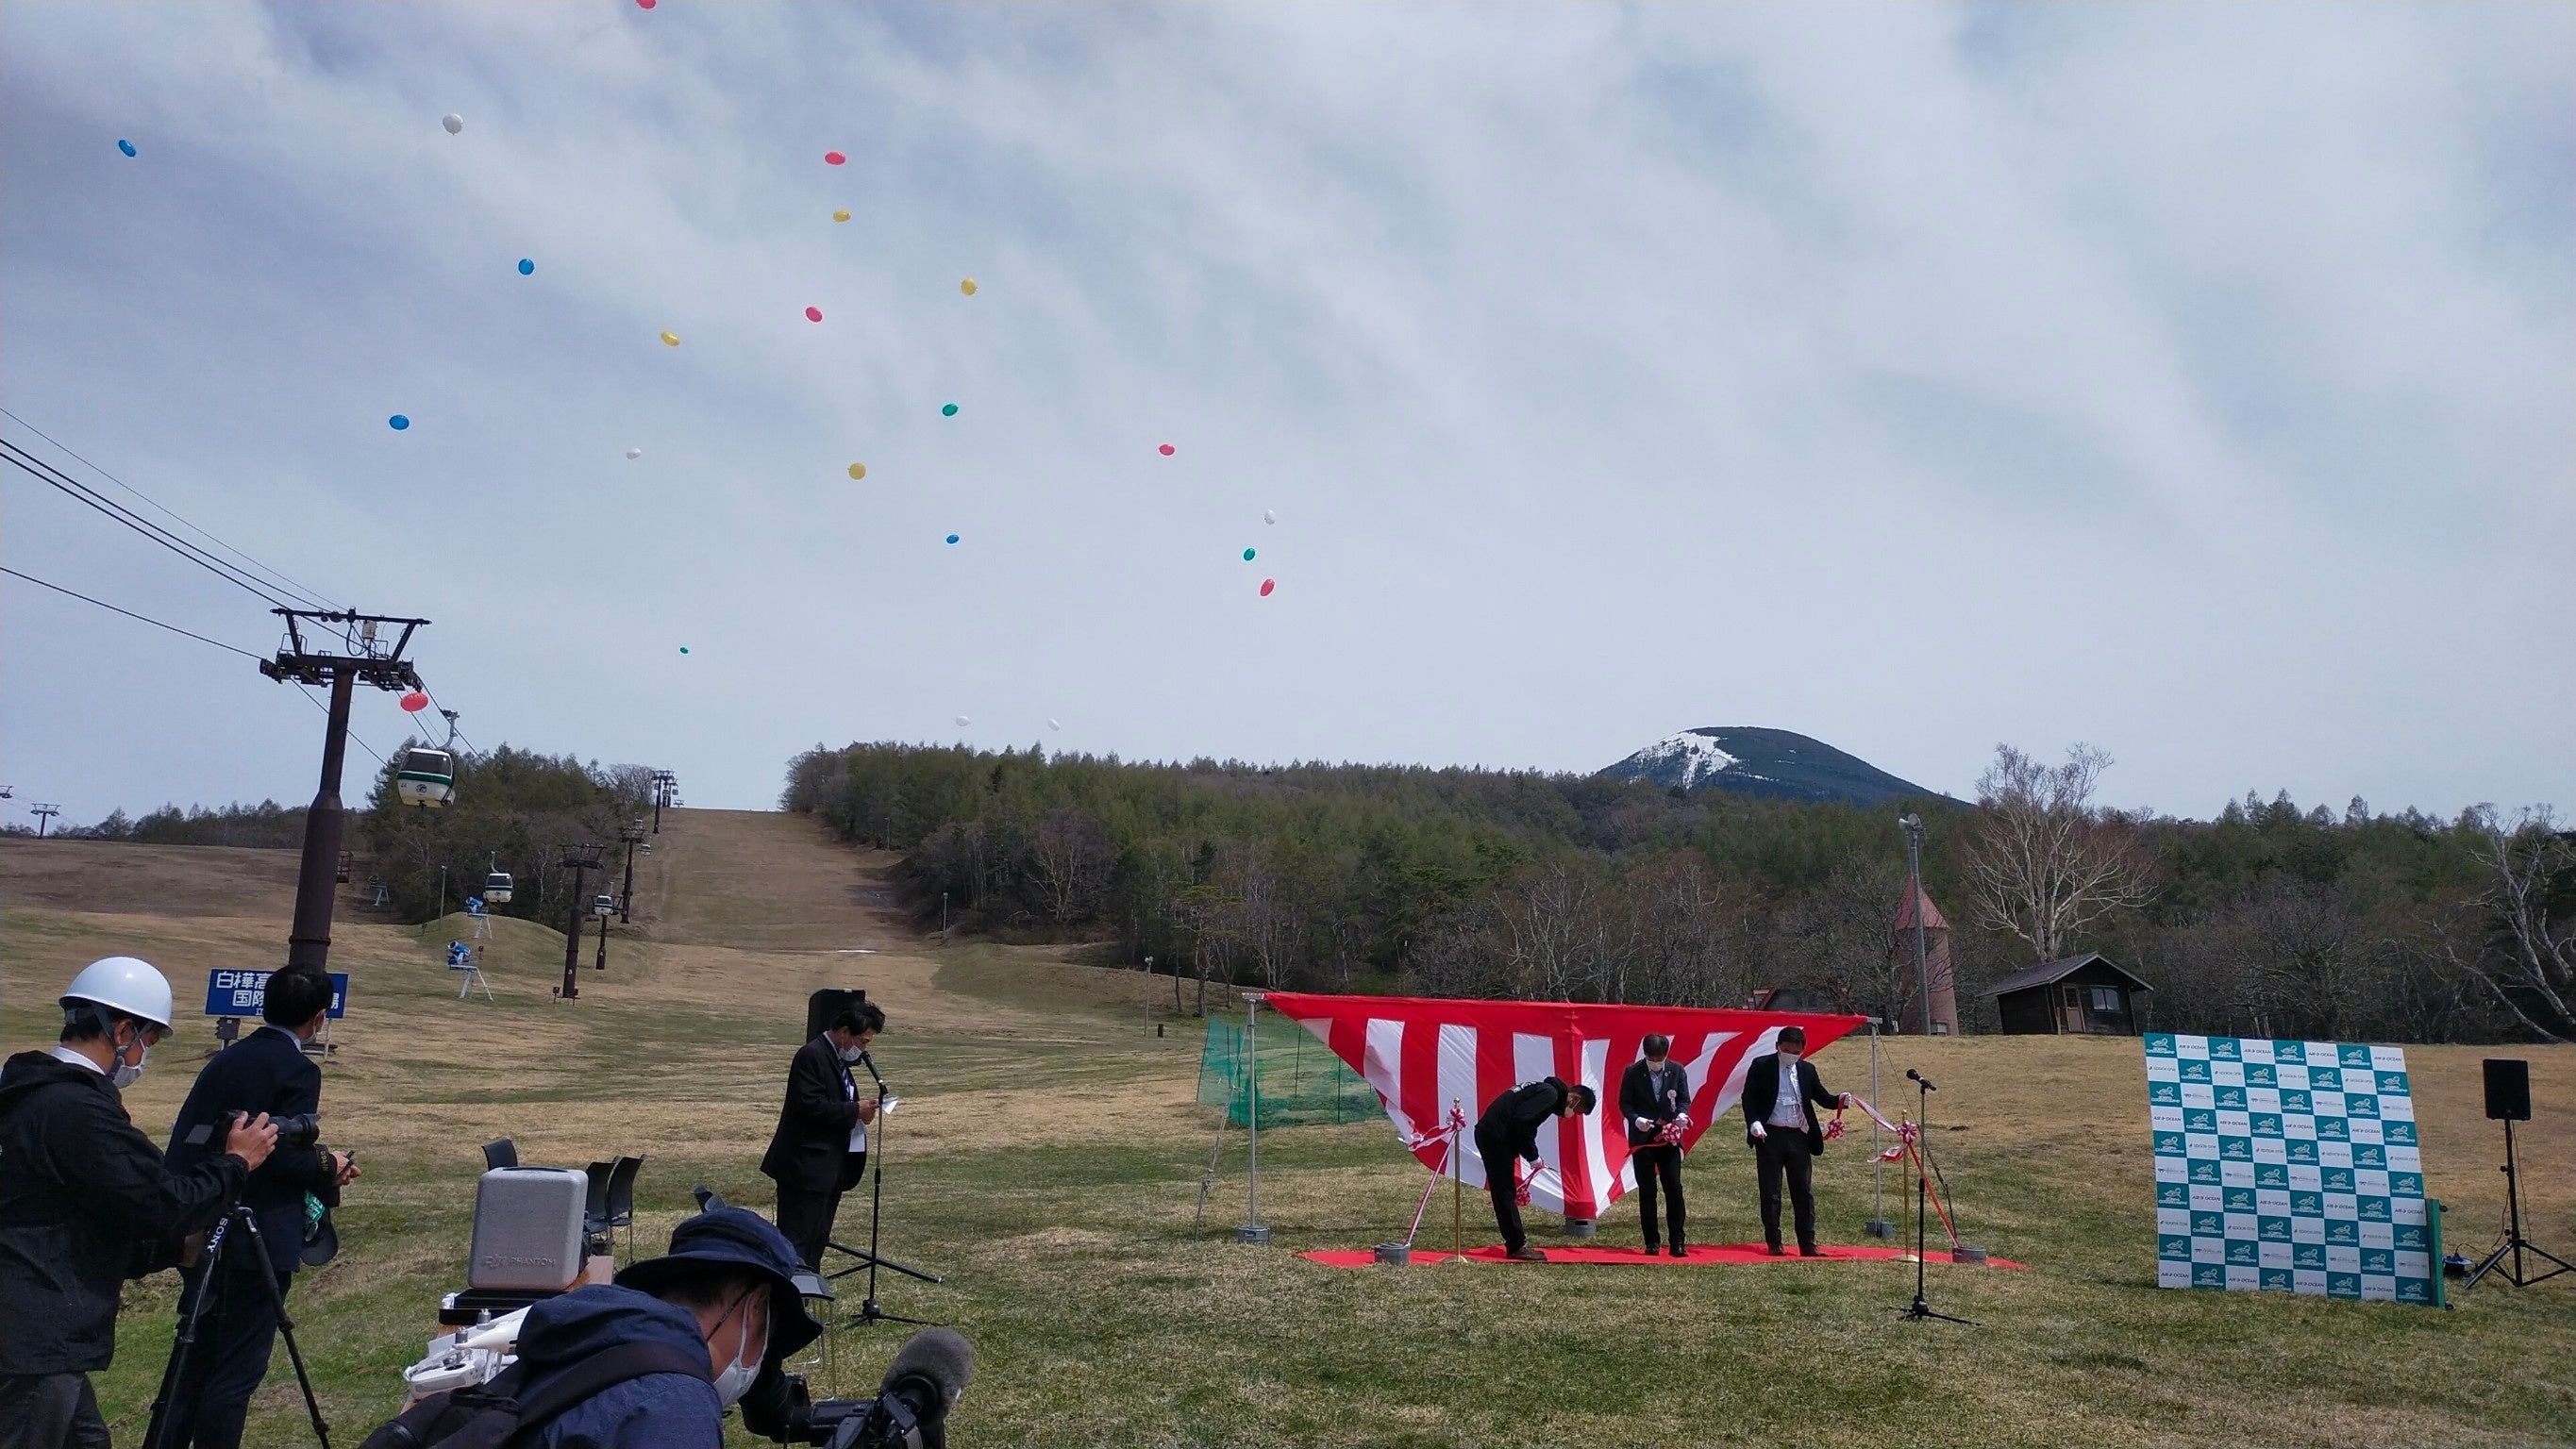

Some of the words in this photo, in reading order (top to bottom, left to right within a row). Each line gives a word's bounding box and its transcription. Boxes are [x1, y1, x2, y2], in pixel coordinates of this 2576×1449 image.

[216, 971, 272, 990] 白樺高
[207, 1217, 228, 1253] SONY
[510, 1256, 557, 1267] PHANTOM
